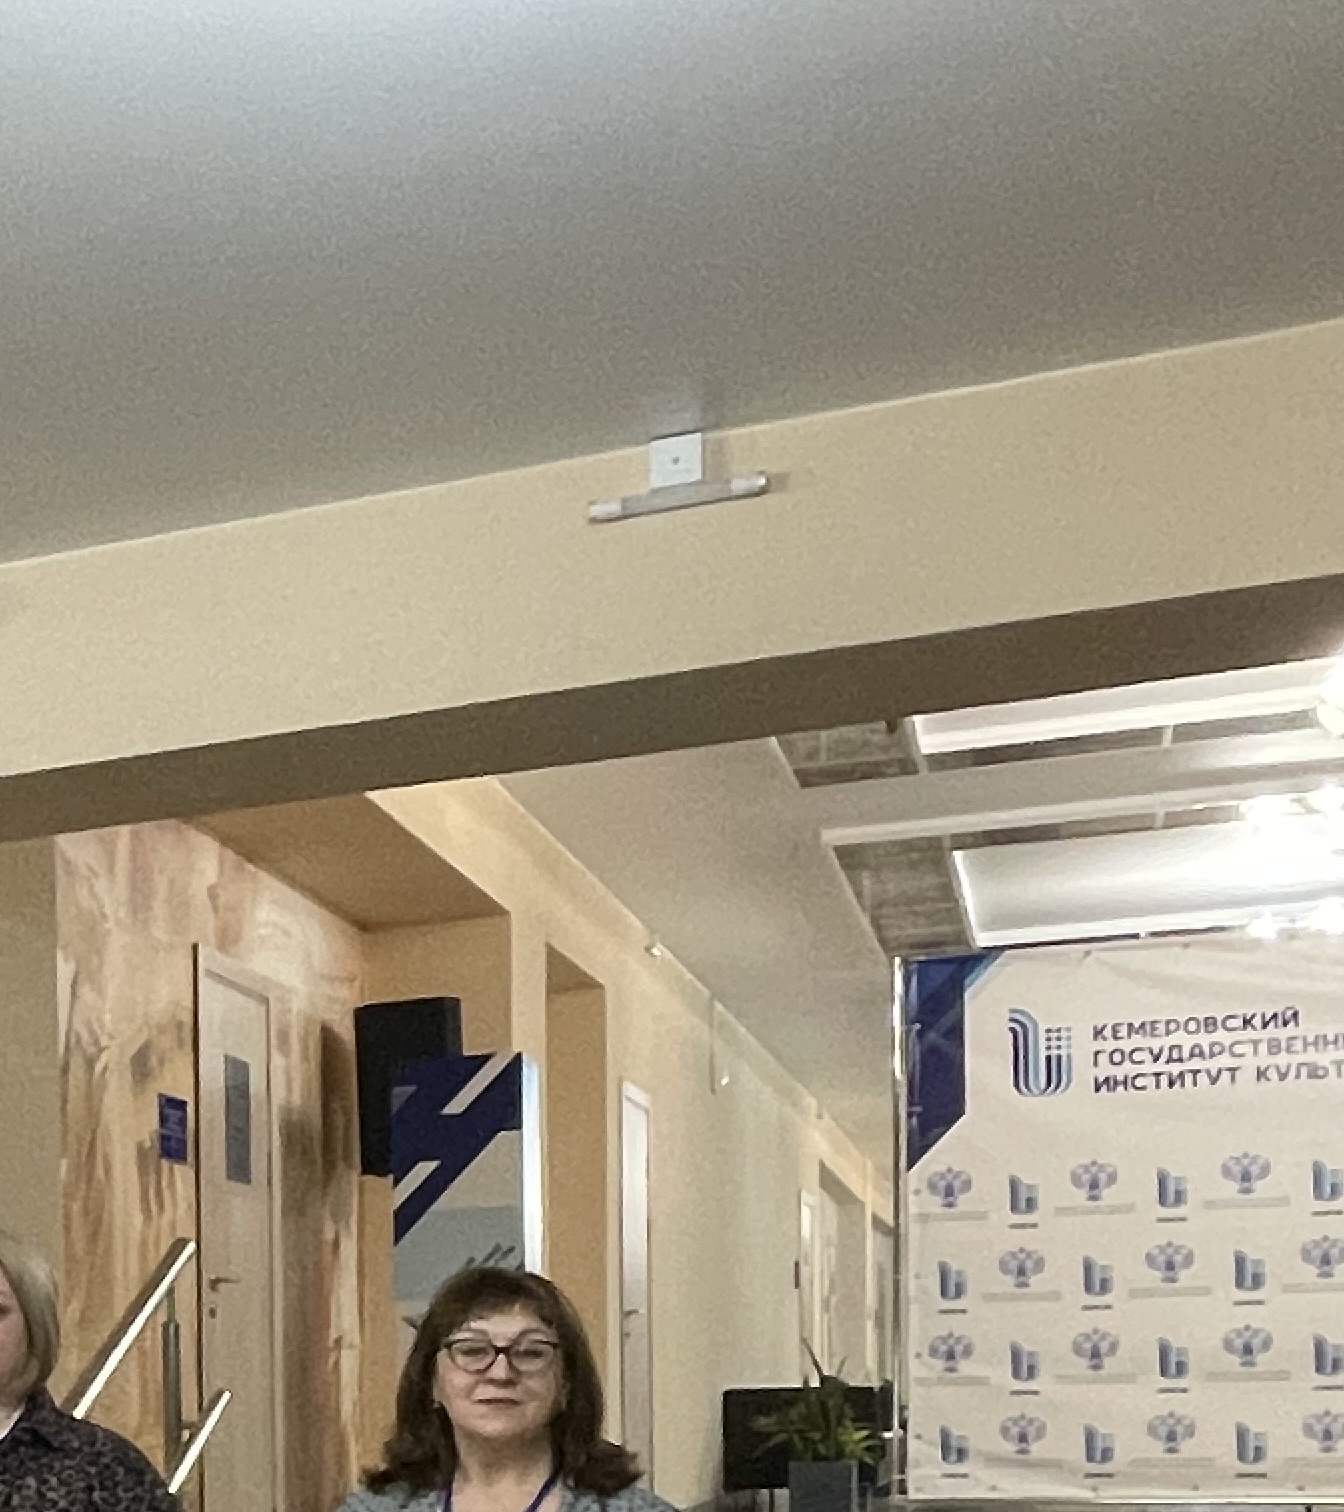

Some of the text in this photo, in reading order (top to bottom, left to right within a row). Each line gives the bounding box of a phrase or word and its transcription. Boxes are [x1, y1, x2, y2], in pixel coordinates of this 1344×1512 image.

[1092, 1005, 1300, 1041] КЕМЕРОВСКИЙ
[1092, 1032, 1344, 1068] ГОСУДАРСТВЕНН
[1093, 1065, 1242, 1094] ИНСТИТУТ
